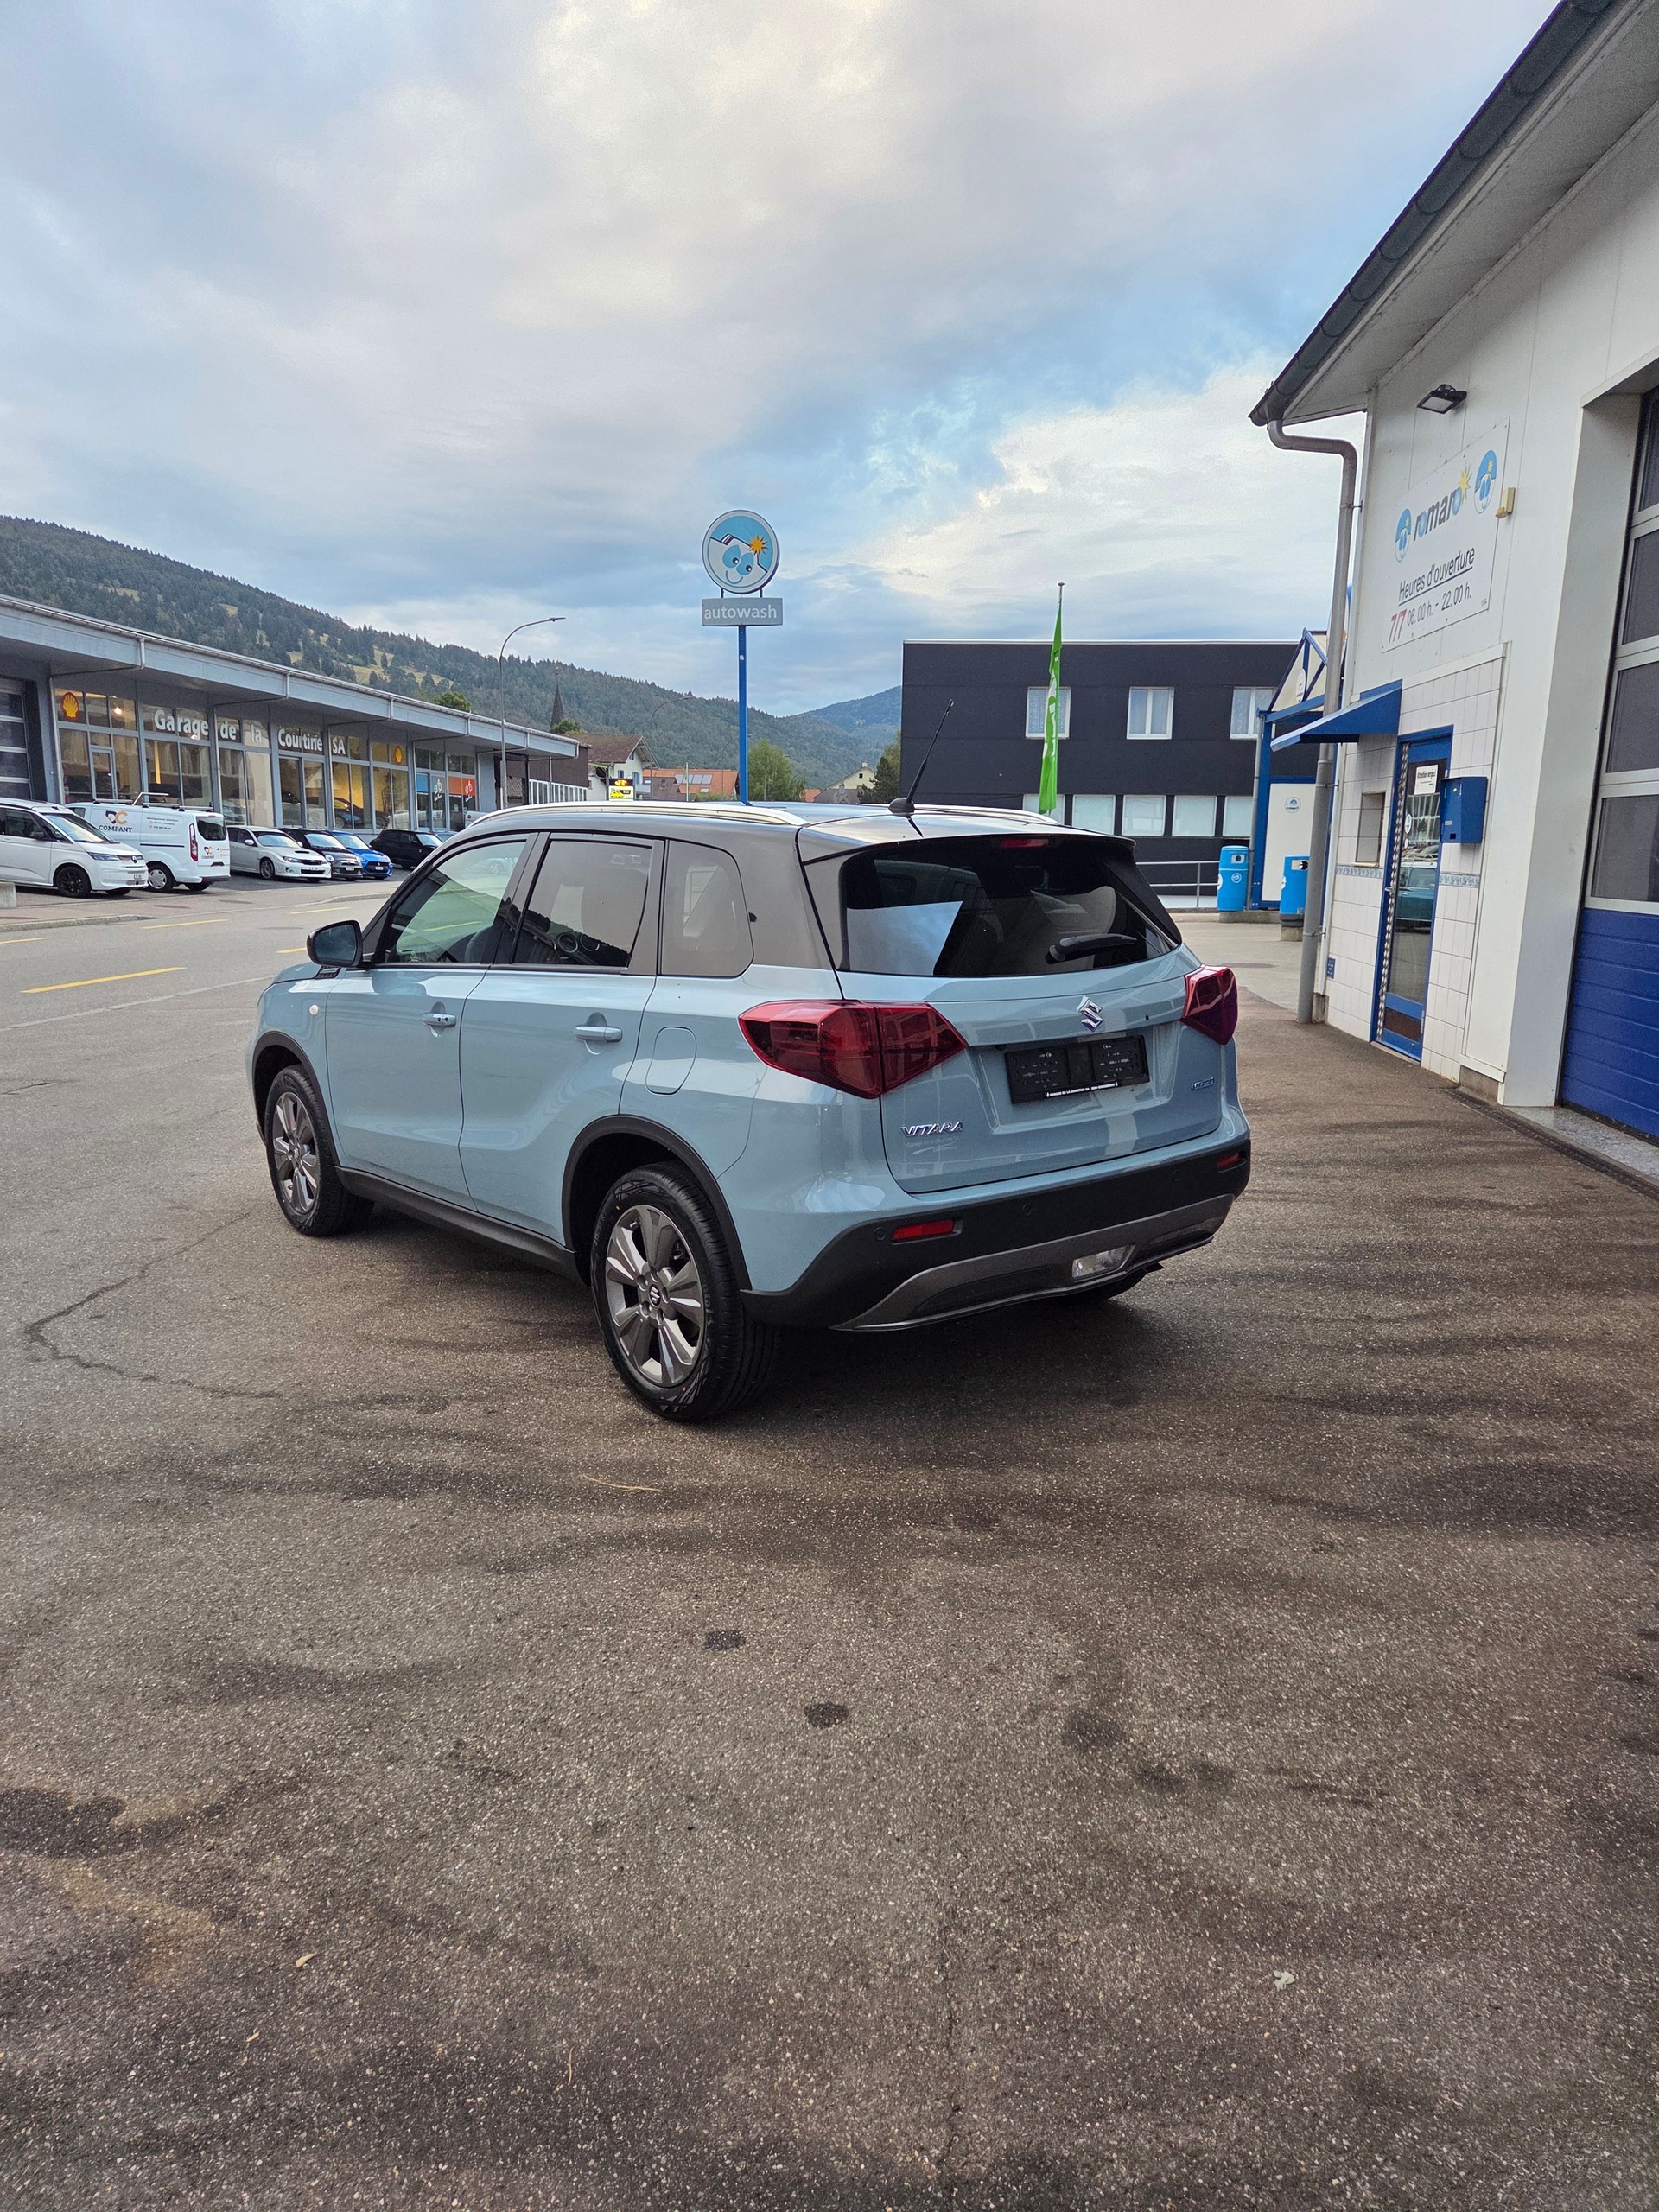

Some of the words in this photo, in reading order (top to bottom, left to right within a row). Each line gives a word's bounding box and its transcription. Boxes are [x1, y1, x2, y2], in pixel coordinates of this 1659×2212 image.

[1413, 486, 1463, 542] romaro
[1398, 574, 1426, 602] Heures
[1427, 547, 1475, 587] d'ouverture
[704, 604, 778, 620] autowash
[1389, 608, 1408, 644] 7/7
[154, 709, 209, 741] Garage
[219, 719, 237, 741] de
[251, 724, 263, 743] la
[277, 728, 323, 752] Courtine
[332, 736, 346, 755] SA
[99, 824, 133, 833] COMPANY
[900, 1121, 963, 1137] VITARA
